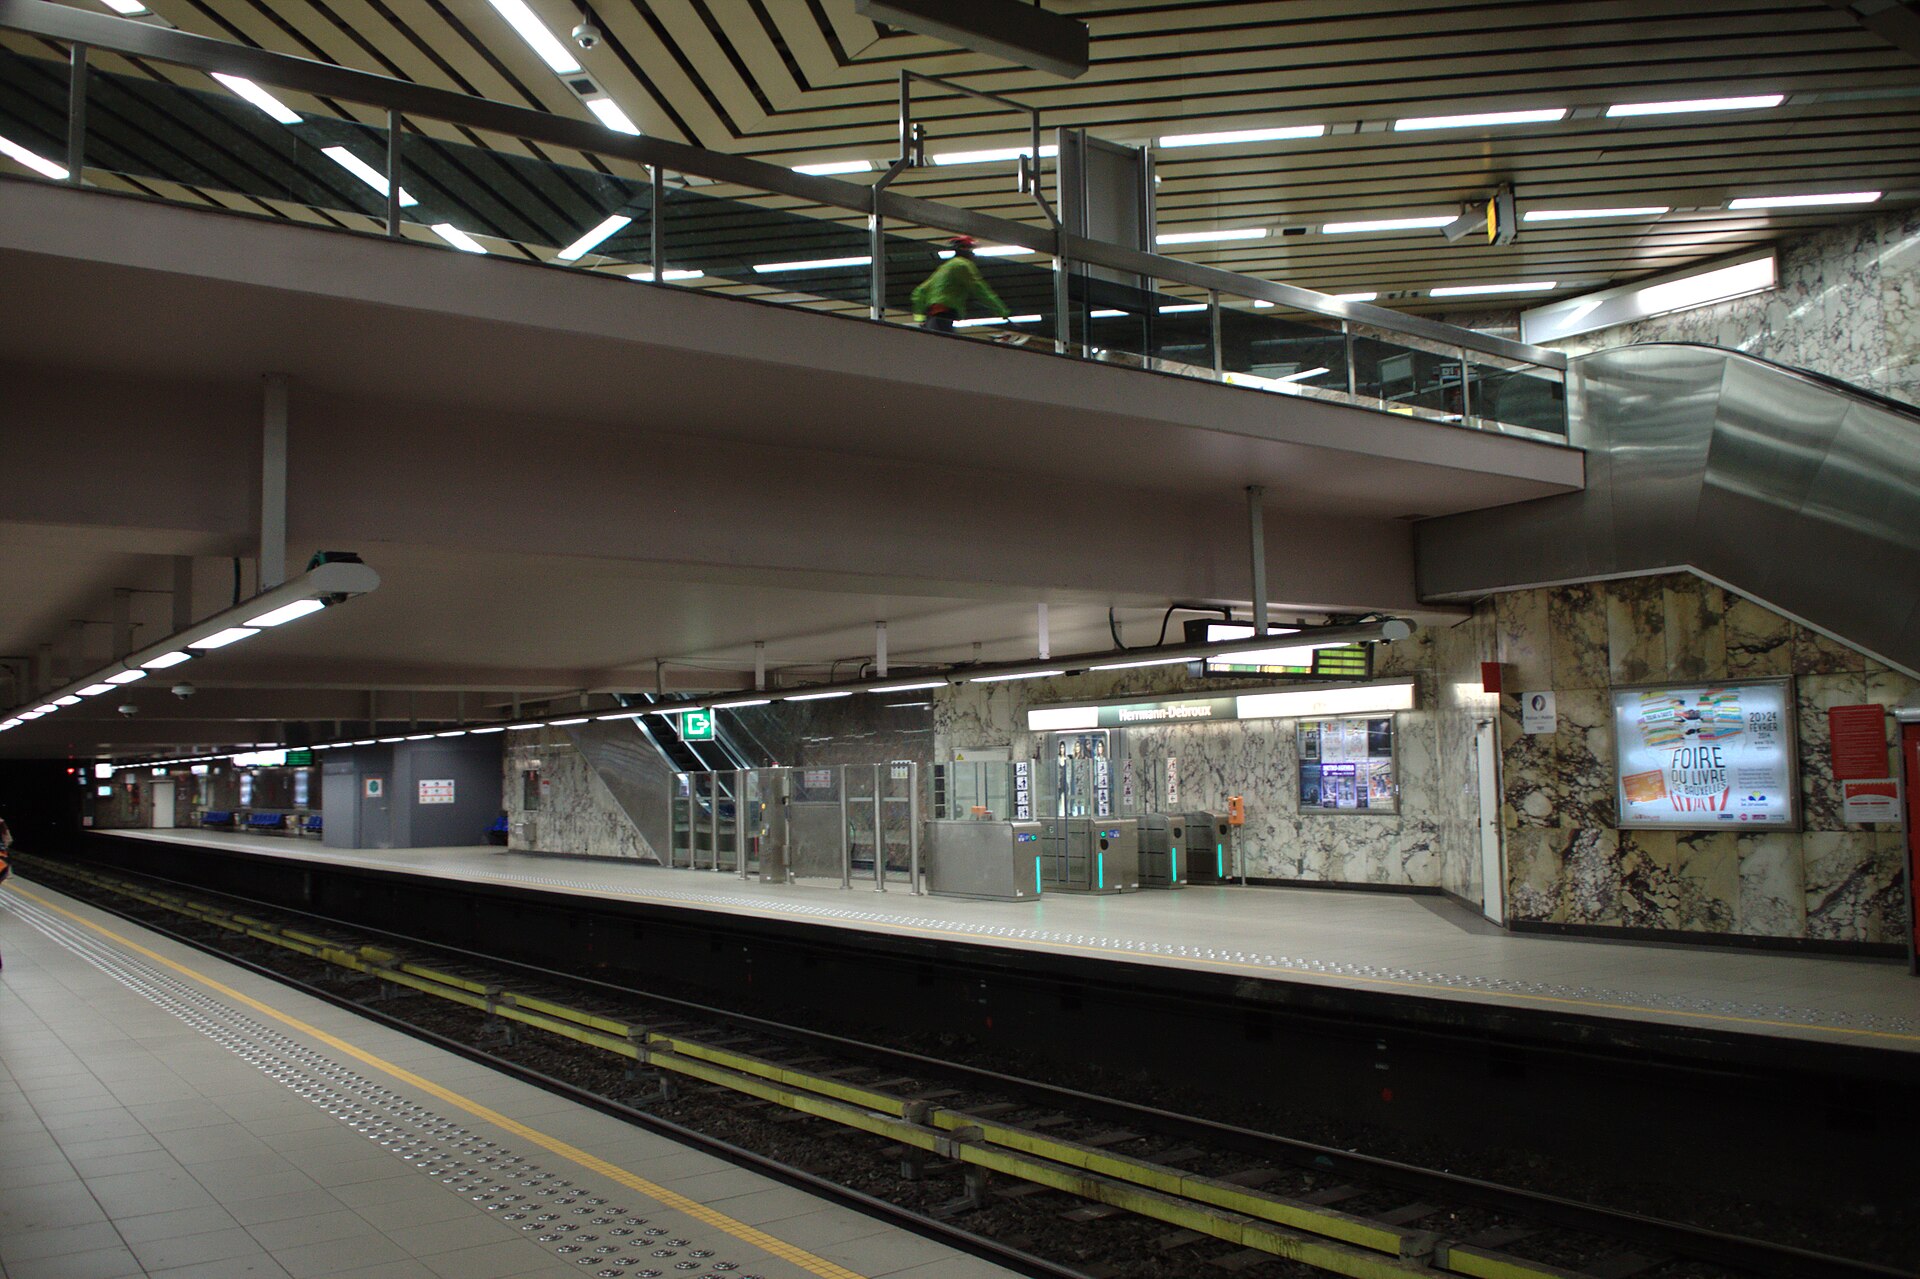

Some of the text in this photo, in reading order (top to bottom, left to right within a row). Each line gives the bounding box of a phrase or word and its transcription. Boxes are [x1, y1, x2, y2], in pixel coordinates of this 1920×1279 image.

[1119, 705, 1212, 721] Herrmann-Debroux
[1672, 746, 1726, 769] FOIRE
[1671, 769, 1687, 785] DU
[1691, 769, 1727, 786] LIVRE
[1684, 781, 1727, 796] BRUXELLES
